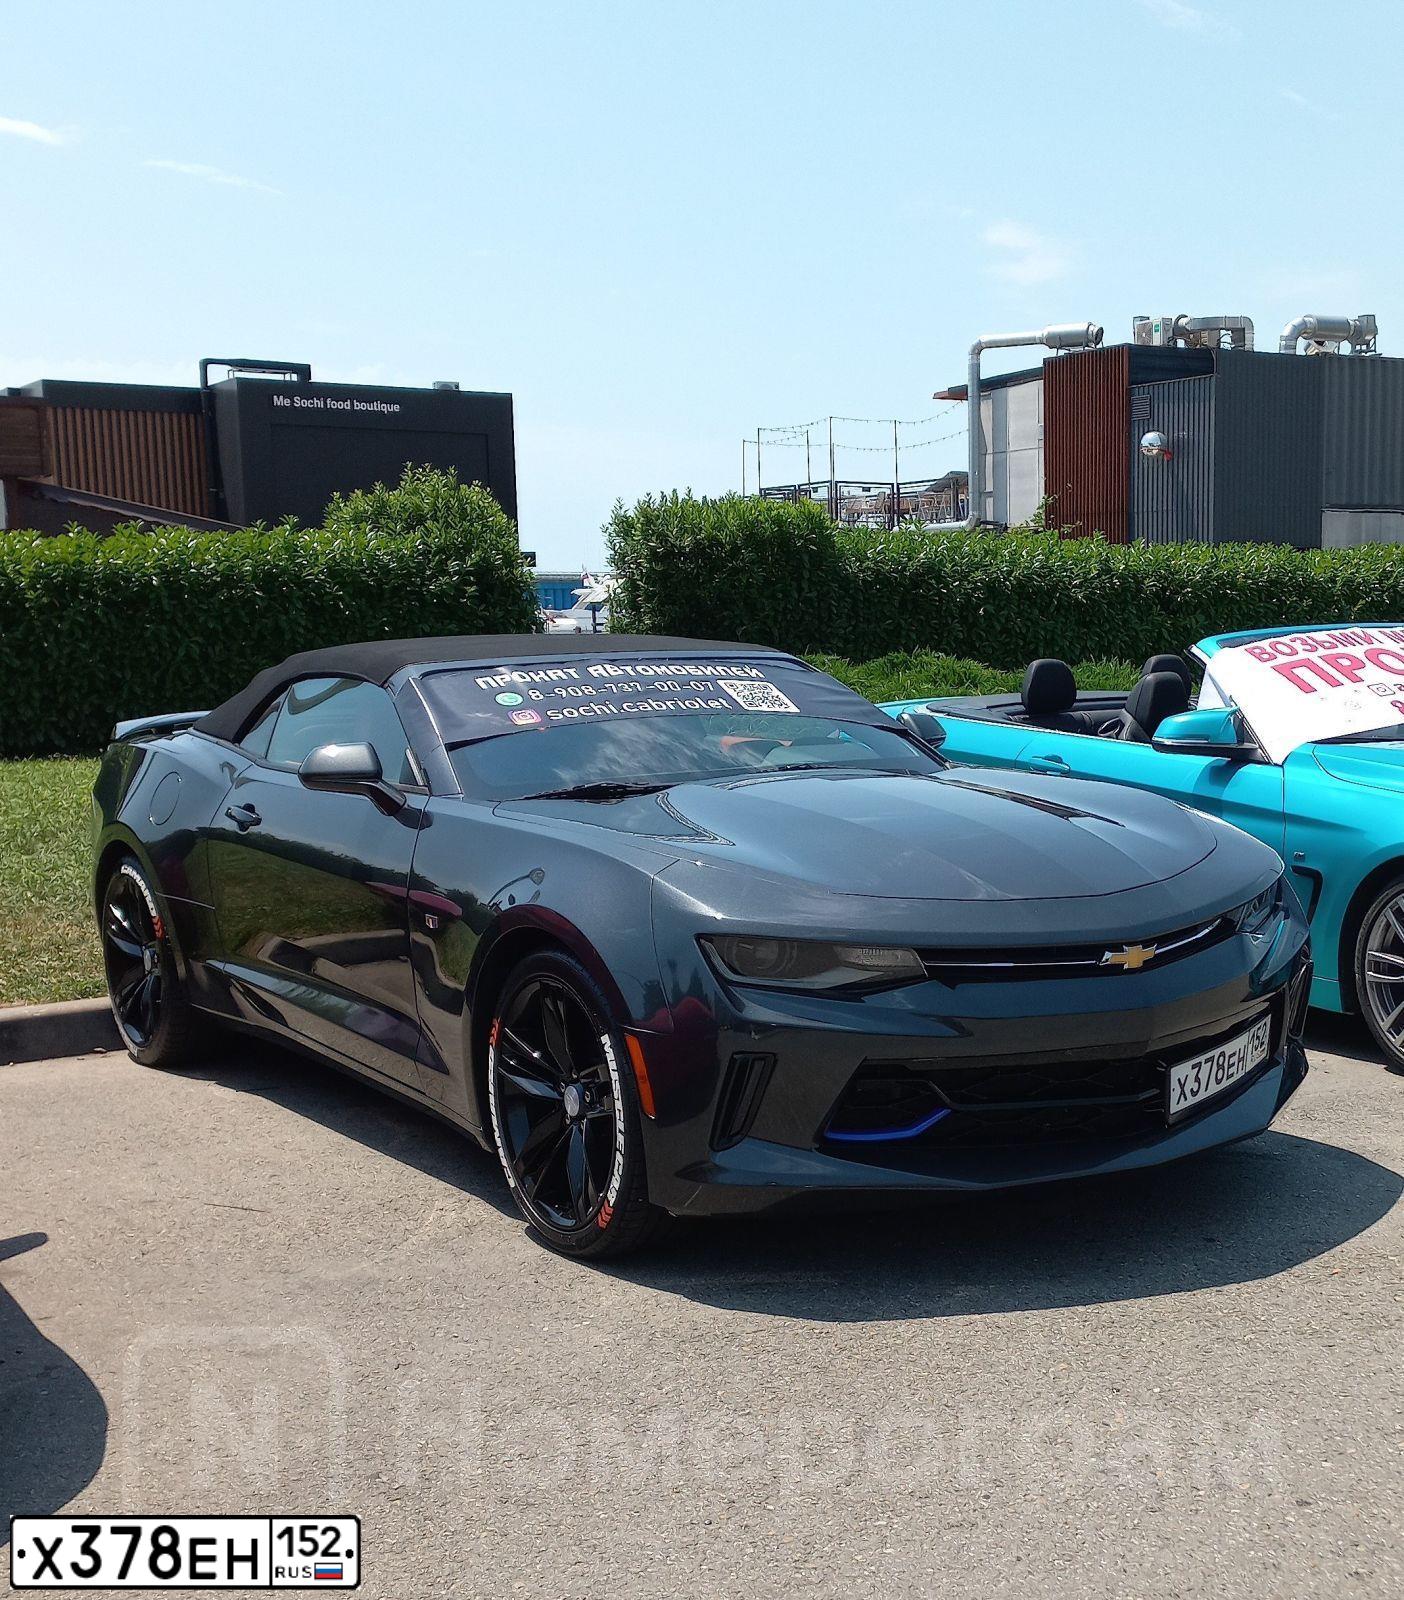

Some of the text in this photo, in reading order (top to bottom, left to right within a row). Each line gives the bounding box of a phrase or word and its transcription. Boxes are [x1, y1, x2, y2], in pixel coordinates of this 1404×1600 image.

[273, 395, 400, 414] Me Sochi food boutique
[1244, 628, 1385, 663] ВОЗЬМИ
[1270, 647, 1404, 694] ПРО
[527, 680, 715, 702] 8-908-737-00-07
[546, 697, 733, 721] sochi.cabriolet
[1249, 1020, 1267, 1055] 152
[600, 1033, 625, 1155] MUSCLE
